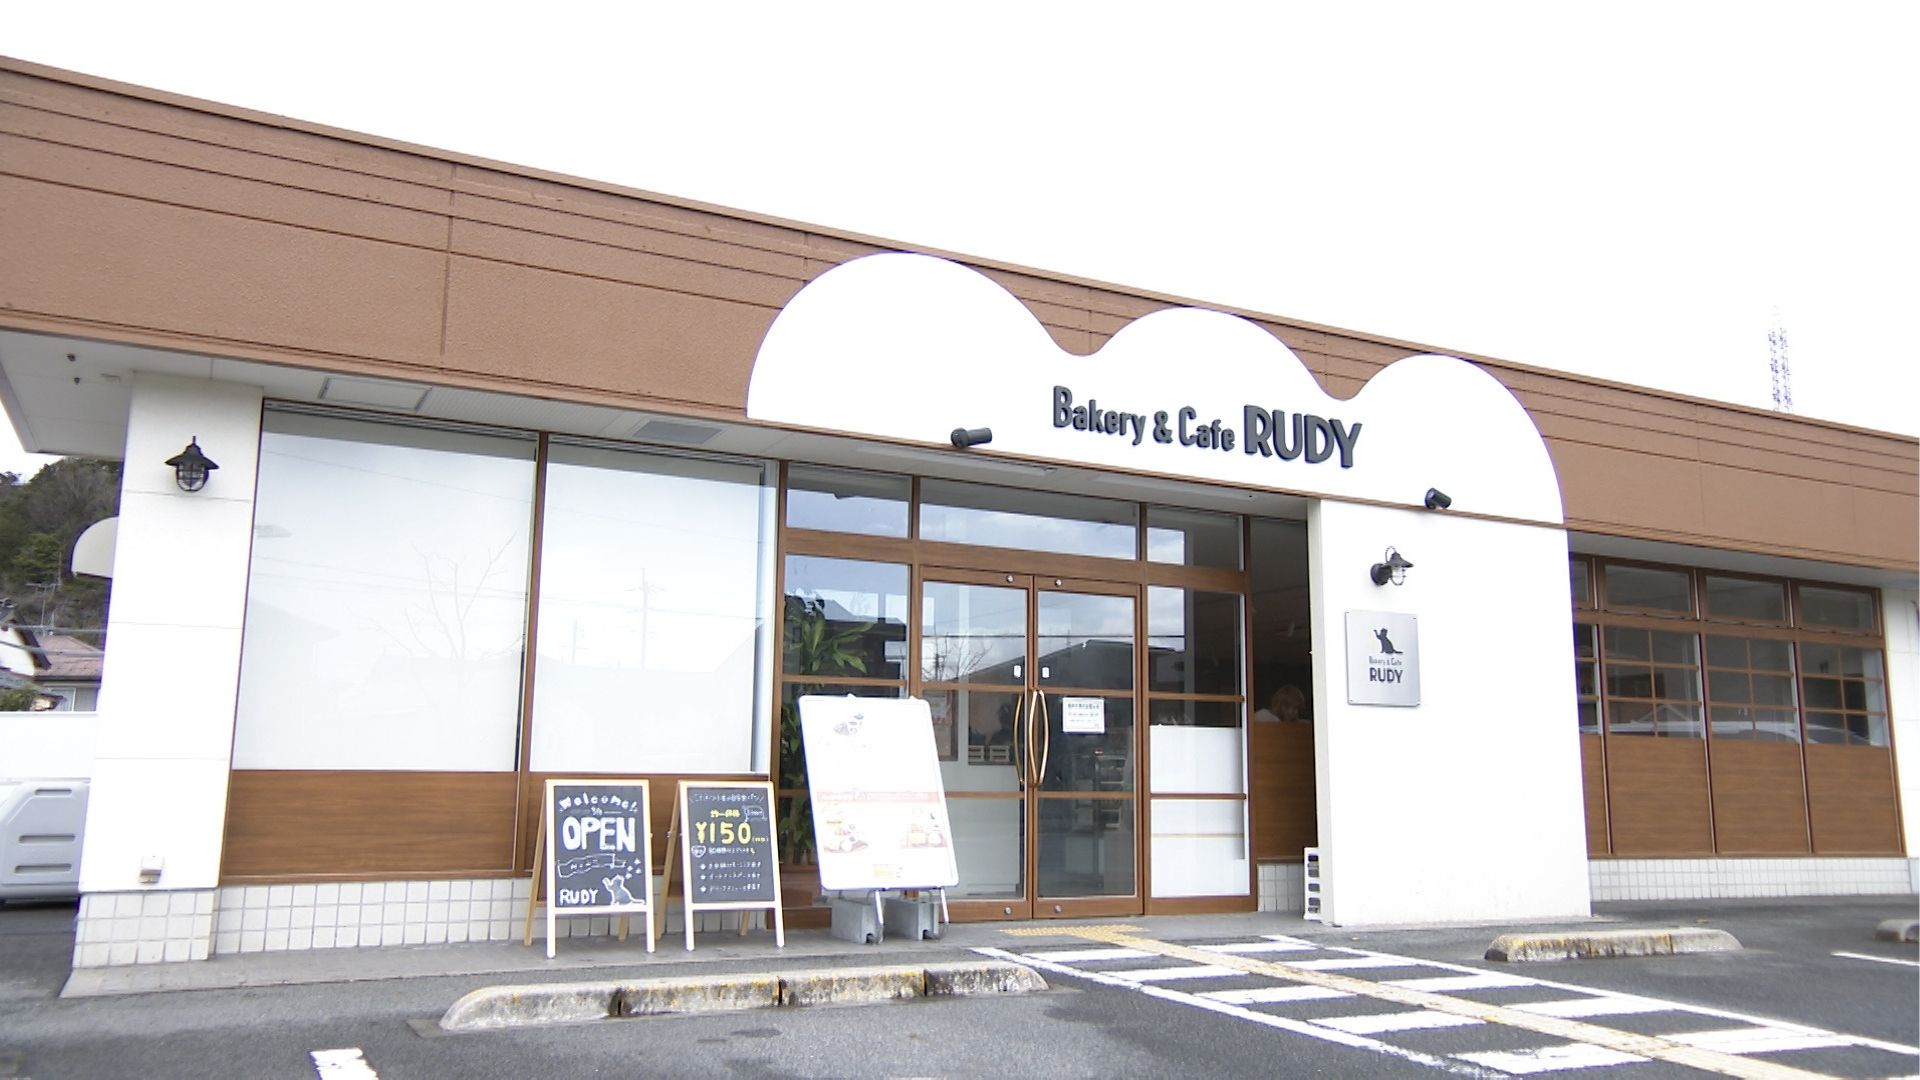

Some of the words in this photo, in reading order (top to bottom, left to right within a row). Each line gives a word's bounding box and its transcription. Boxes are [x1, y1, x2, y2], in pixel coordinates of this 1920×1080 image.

[1053, 385, 1147, 446] Bakery
[1152, 410, 1173, 443] &
[1178, 405, 1235, 451] Cafe
[1243, 404, 1363, 469] RUDY
[1369, 667, 1403, 684] RUDY
[562, 816, 636, 852] OPEN
[559, 888, 599, 905] RUDY
